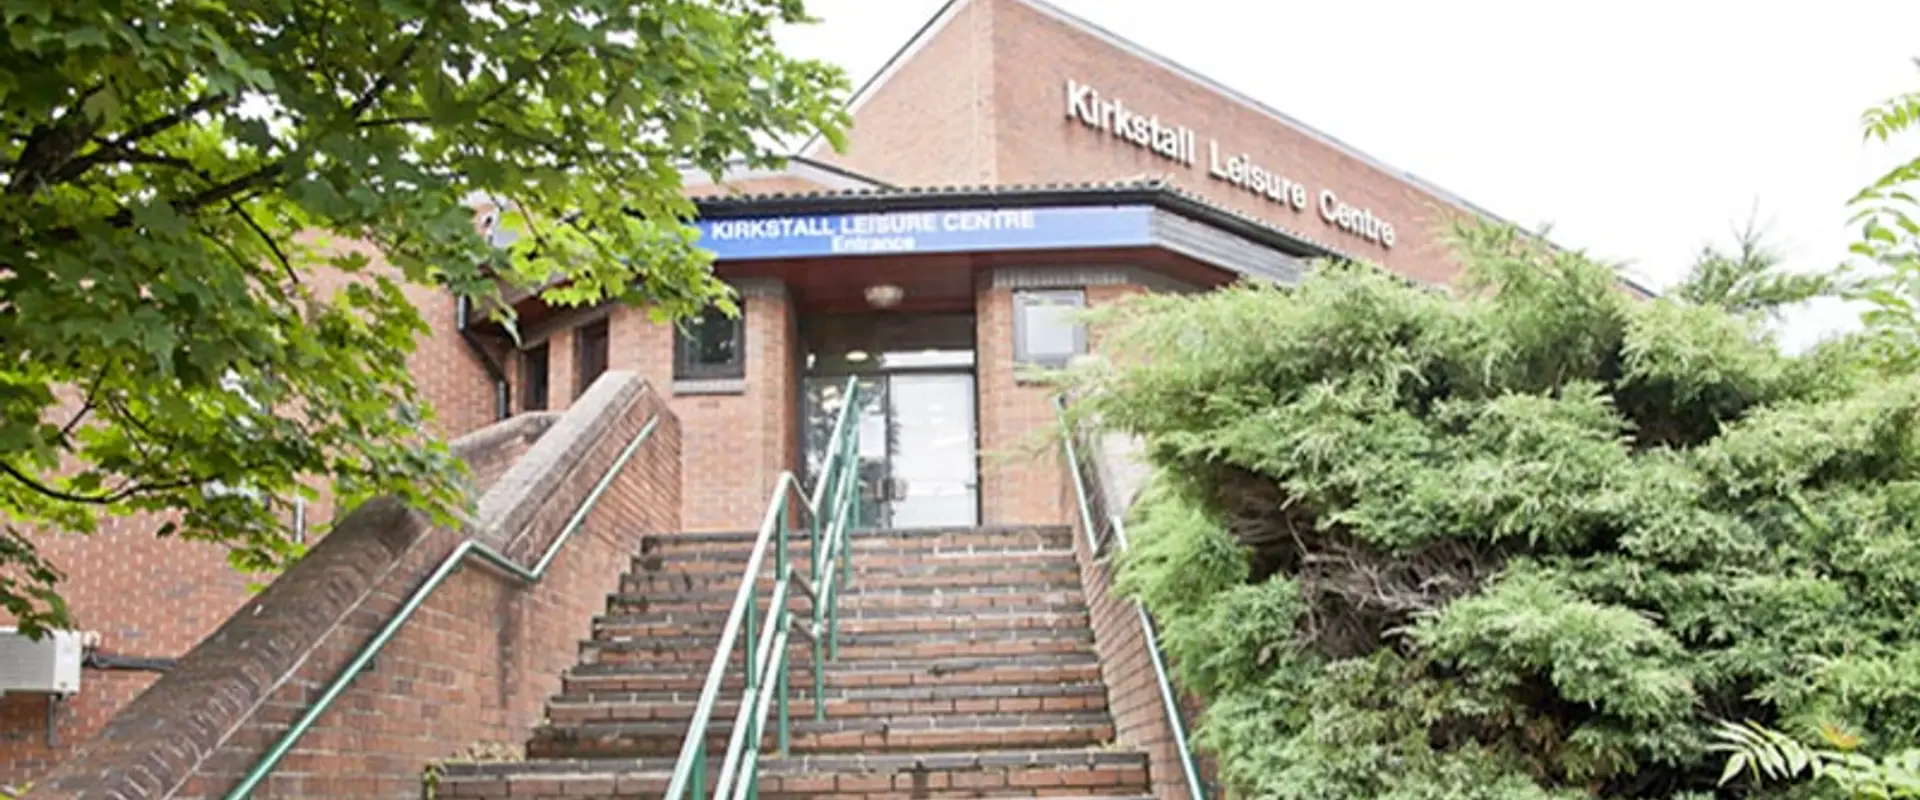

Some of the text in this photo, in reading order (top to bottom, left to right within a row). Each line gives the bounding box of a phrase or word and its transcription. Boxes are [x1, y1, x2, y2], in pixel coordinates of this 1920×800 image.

[1064, 80, 1397, 249] Kirkstall Leisure Centre
[712, 209, 1036, 240] KIRKSTALL LEISURE CENTRE
[831, 234, 916, 252] Entrance
